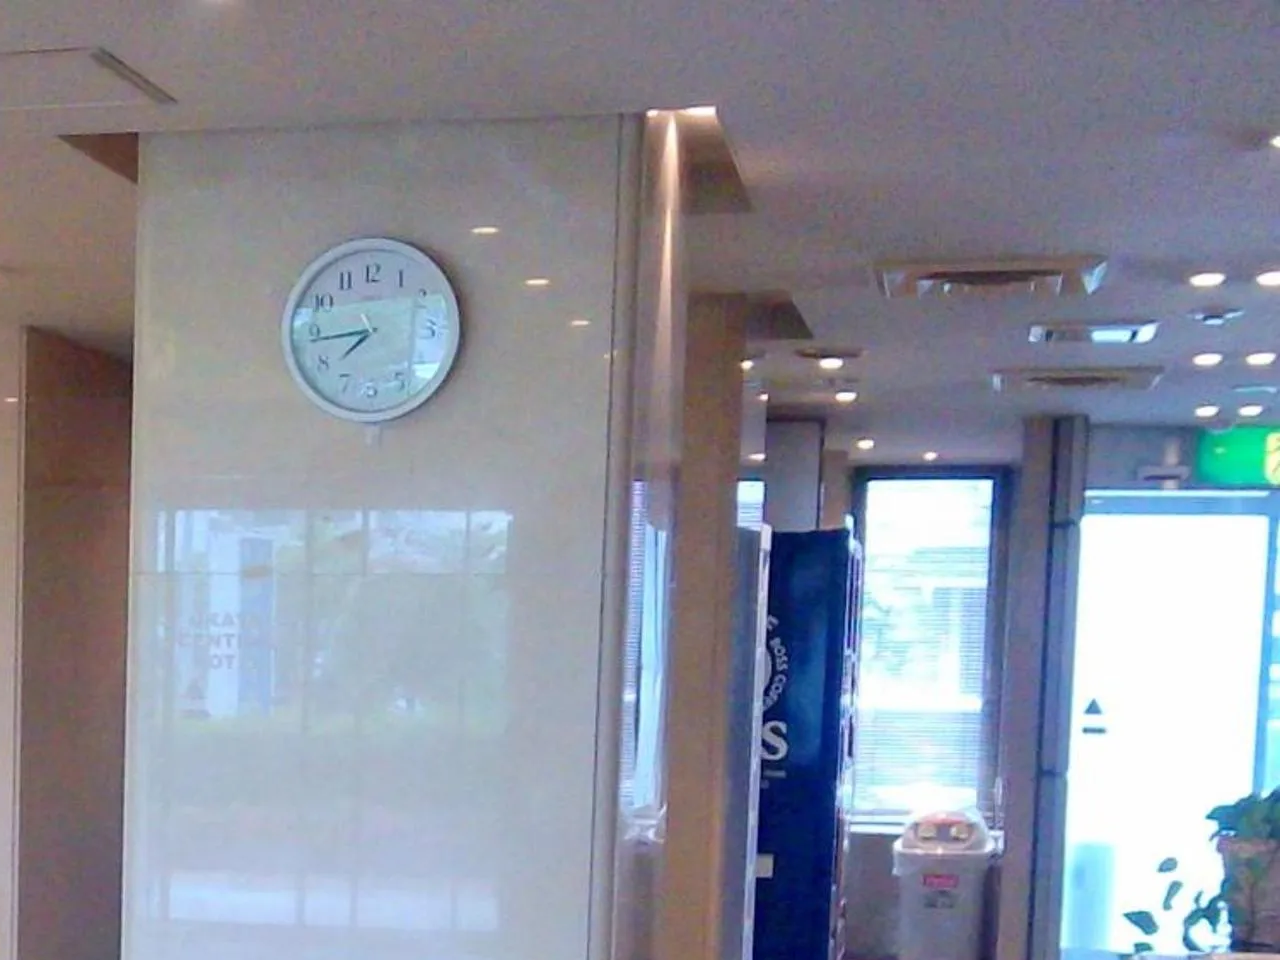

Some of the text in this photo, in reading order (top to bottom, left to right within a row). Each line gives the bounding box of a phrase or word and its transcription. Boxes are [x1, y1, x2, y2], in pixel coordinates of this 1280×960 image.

[339, 271, 352, 290] 11
[364, 263, 382, 284] 12
[398, 269, 405, 288] 1
[314, 292, 334, 313] 10
[339, 373, 351, 394] 7
